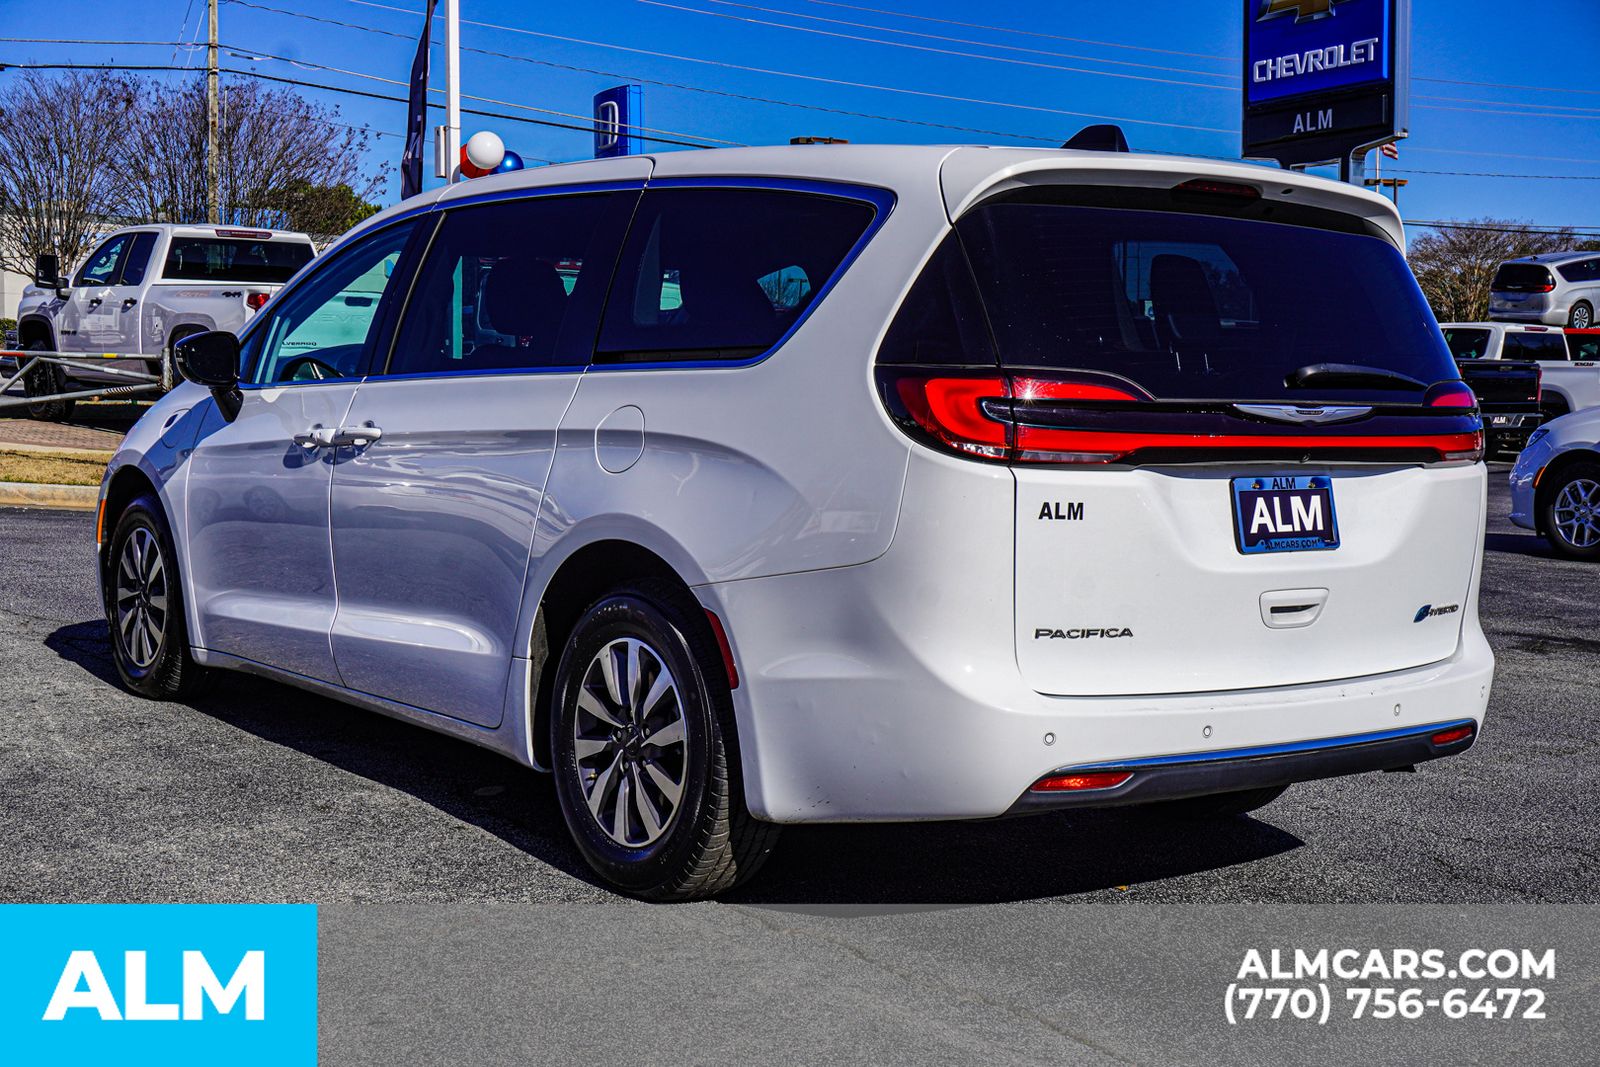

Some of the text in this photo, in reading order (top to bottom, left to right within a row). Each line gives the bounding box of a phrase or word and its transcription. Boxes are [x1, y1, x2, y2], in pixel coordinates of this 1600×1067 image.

[1253, 37, 1379, 83] CHEVROLET
[1292, 108, 1333, 134] ALM
[1271, 477, 1297, 490] ALM
[1038, 501, 1085, 521] ALM
[1249, 495, 1325, 534] ALM
[1034, 627, 1134, 640] PACIFICA
